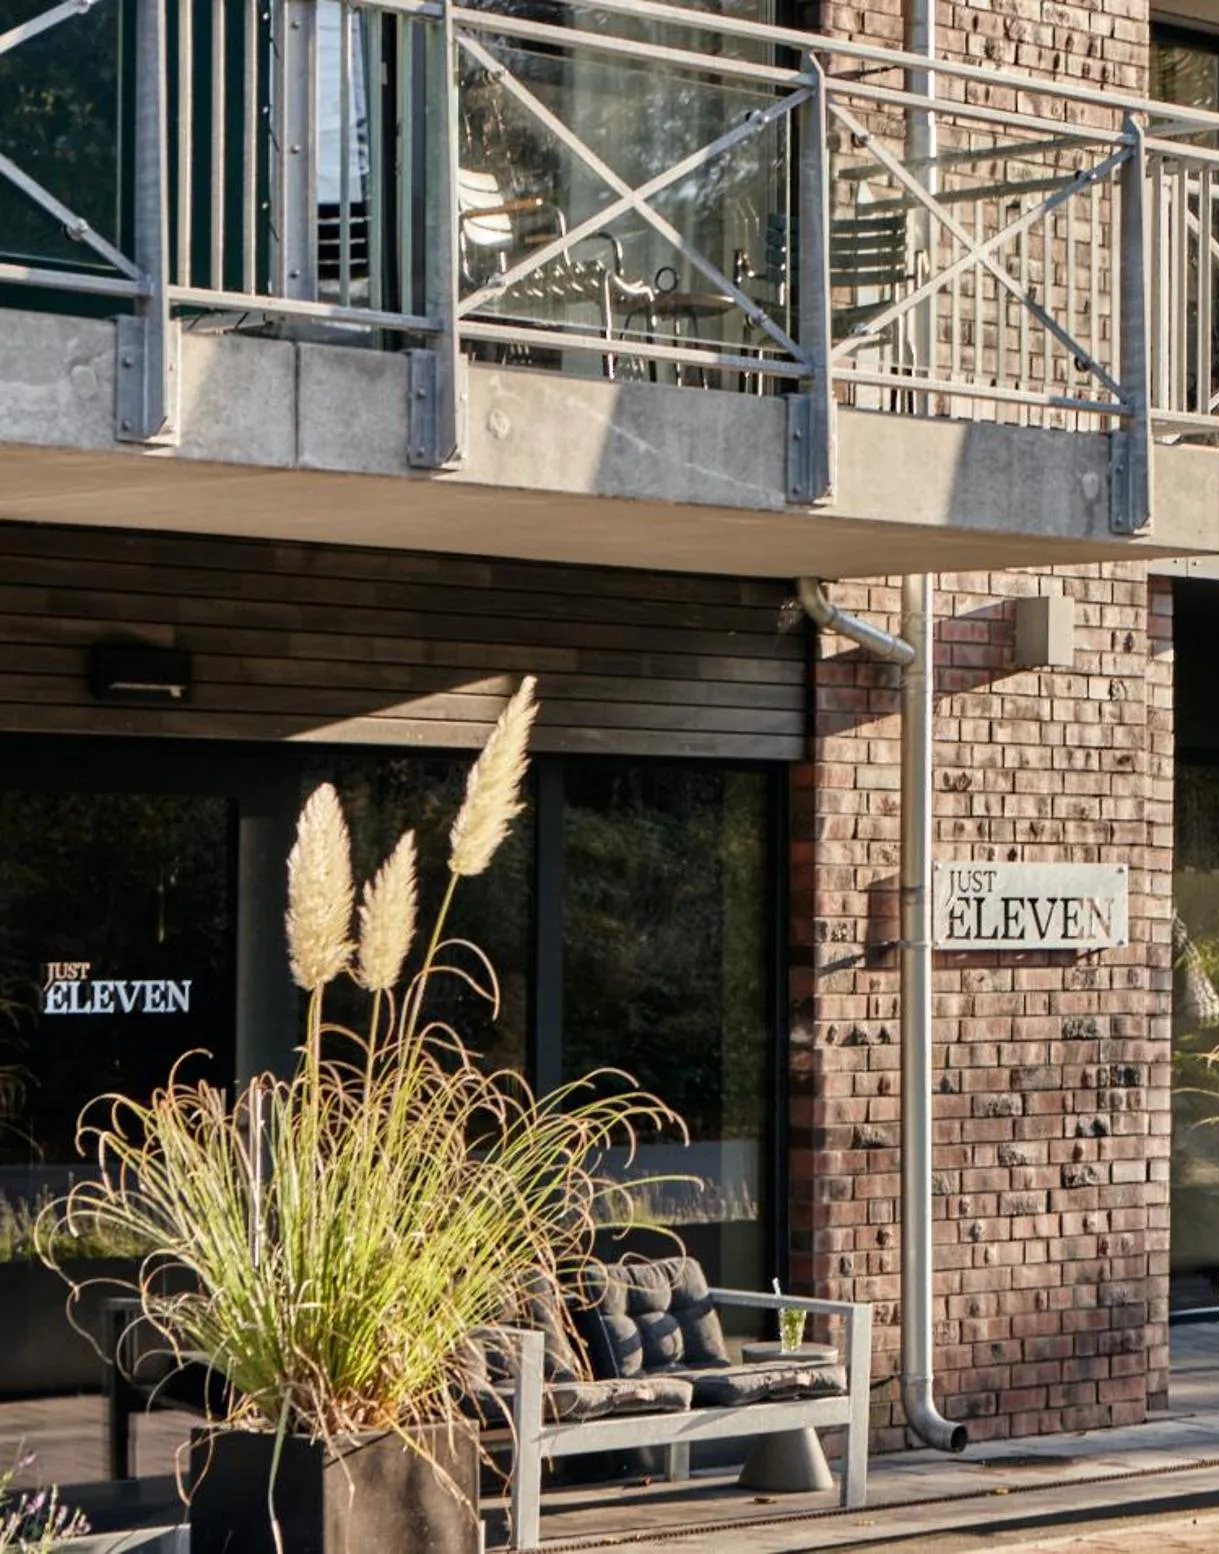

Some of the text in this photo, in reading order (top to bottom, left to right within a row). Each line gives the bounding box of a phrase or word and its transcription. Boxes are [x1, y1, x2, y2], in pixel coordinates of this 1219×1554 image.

[946, 870, 997, 904] JUST
[945, 897, 1115, 941] ELEVEN
[44, 961, 91, 989] JUST
[43, 979, 193, 1014] ELEVEN
